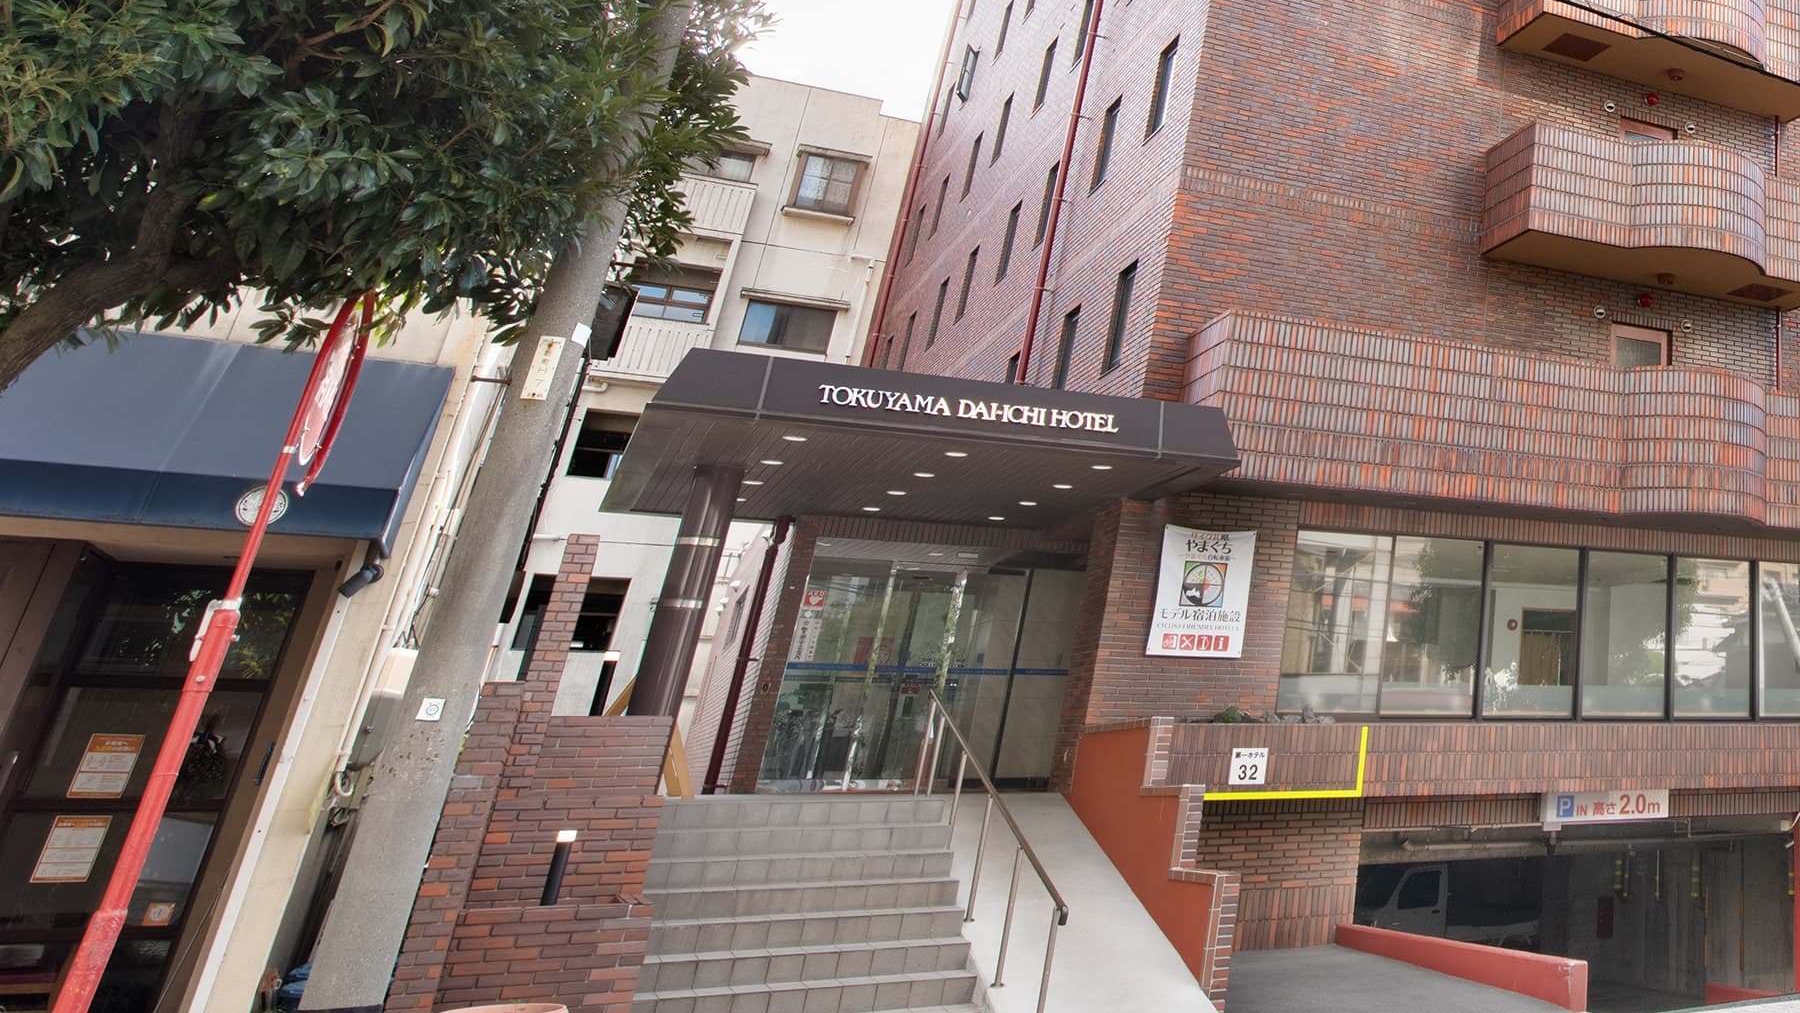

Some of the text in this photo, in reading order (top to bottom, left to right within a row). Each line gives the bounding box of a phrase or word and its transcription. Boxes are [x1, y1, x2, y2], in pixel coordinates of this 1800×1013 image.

[818, 384, 1119, 434] TOKUYAMA DAI-ICHI HOTEL
[1185, 538, 1233, 555] やまぐち
[1159, 607, 1241, 623] モデル宿泊施設
[1238, 764, 1258, 781] 32
[1559, 793, 1661, 817] P IN 高さ 2.0m
